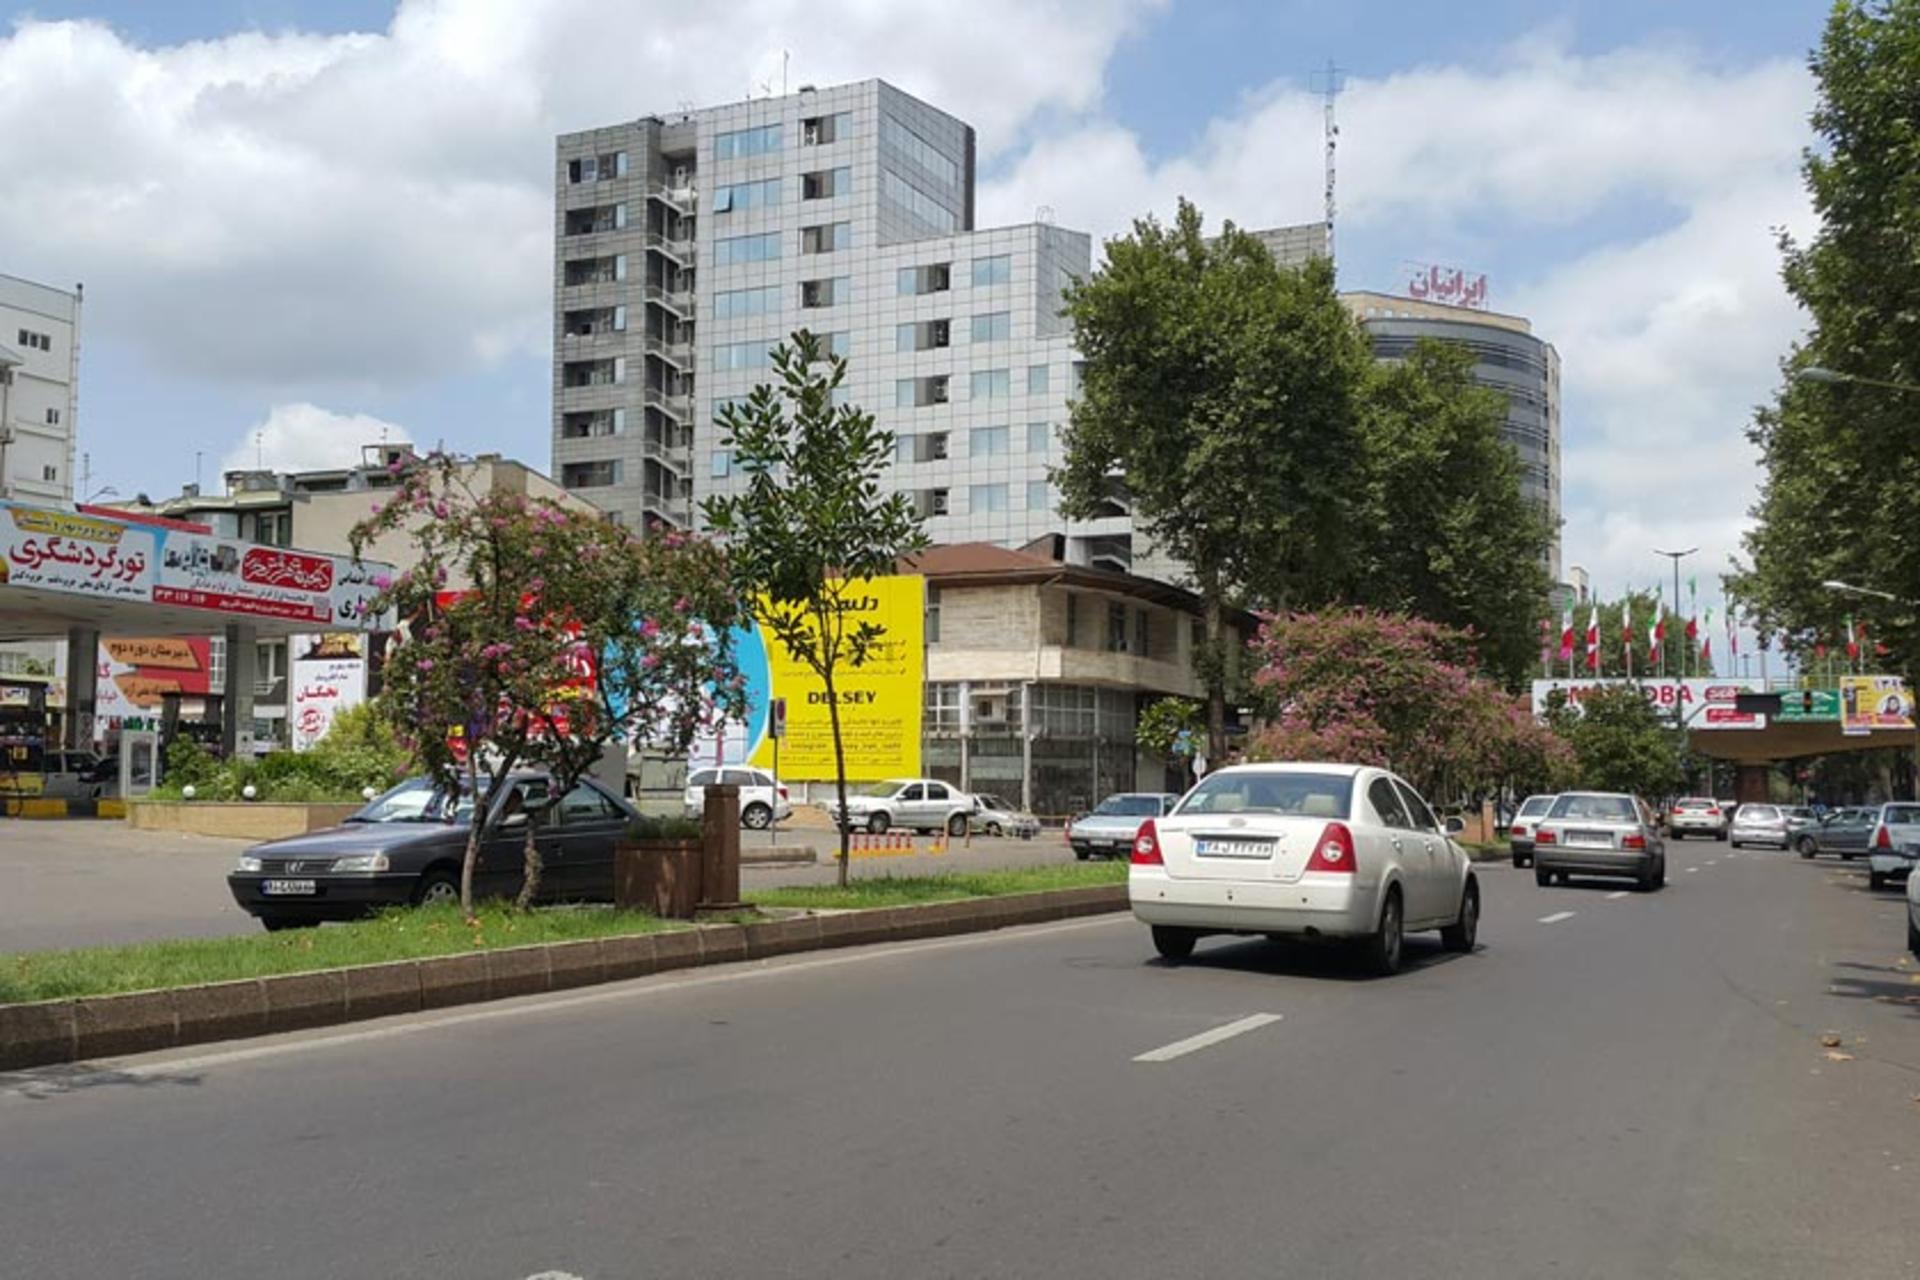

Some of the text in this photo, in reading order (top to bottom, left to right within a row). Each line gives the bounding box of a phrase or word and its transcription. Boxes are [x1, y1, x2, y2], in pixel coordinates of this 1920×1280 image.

[1410, 265, 1487, 306] ایرانیان
[9, 536, 146, 582] تور گردشگری
[808, 690, 876, 705] DELSEY
